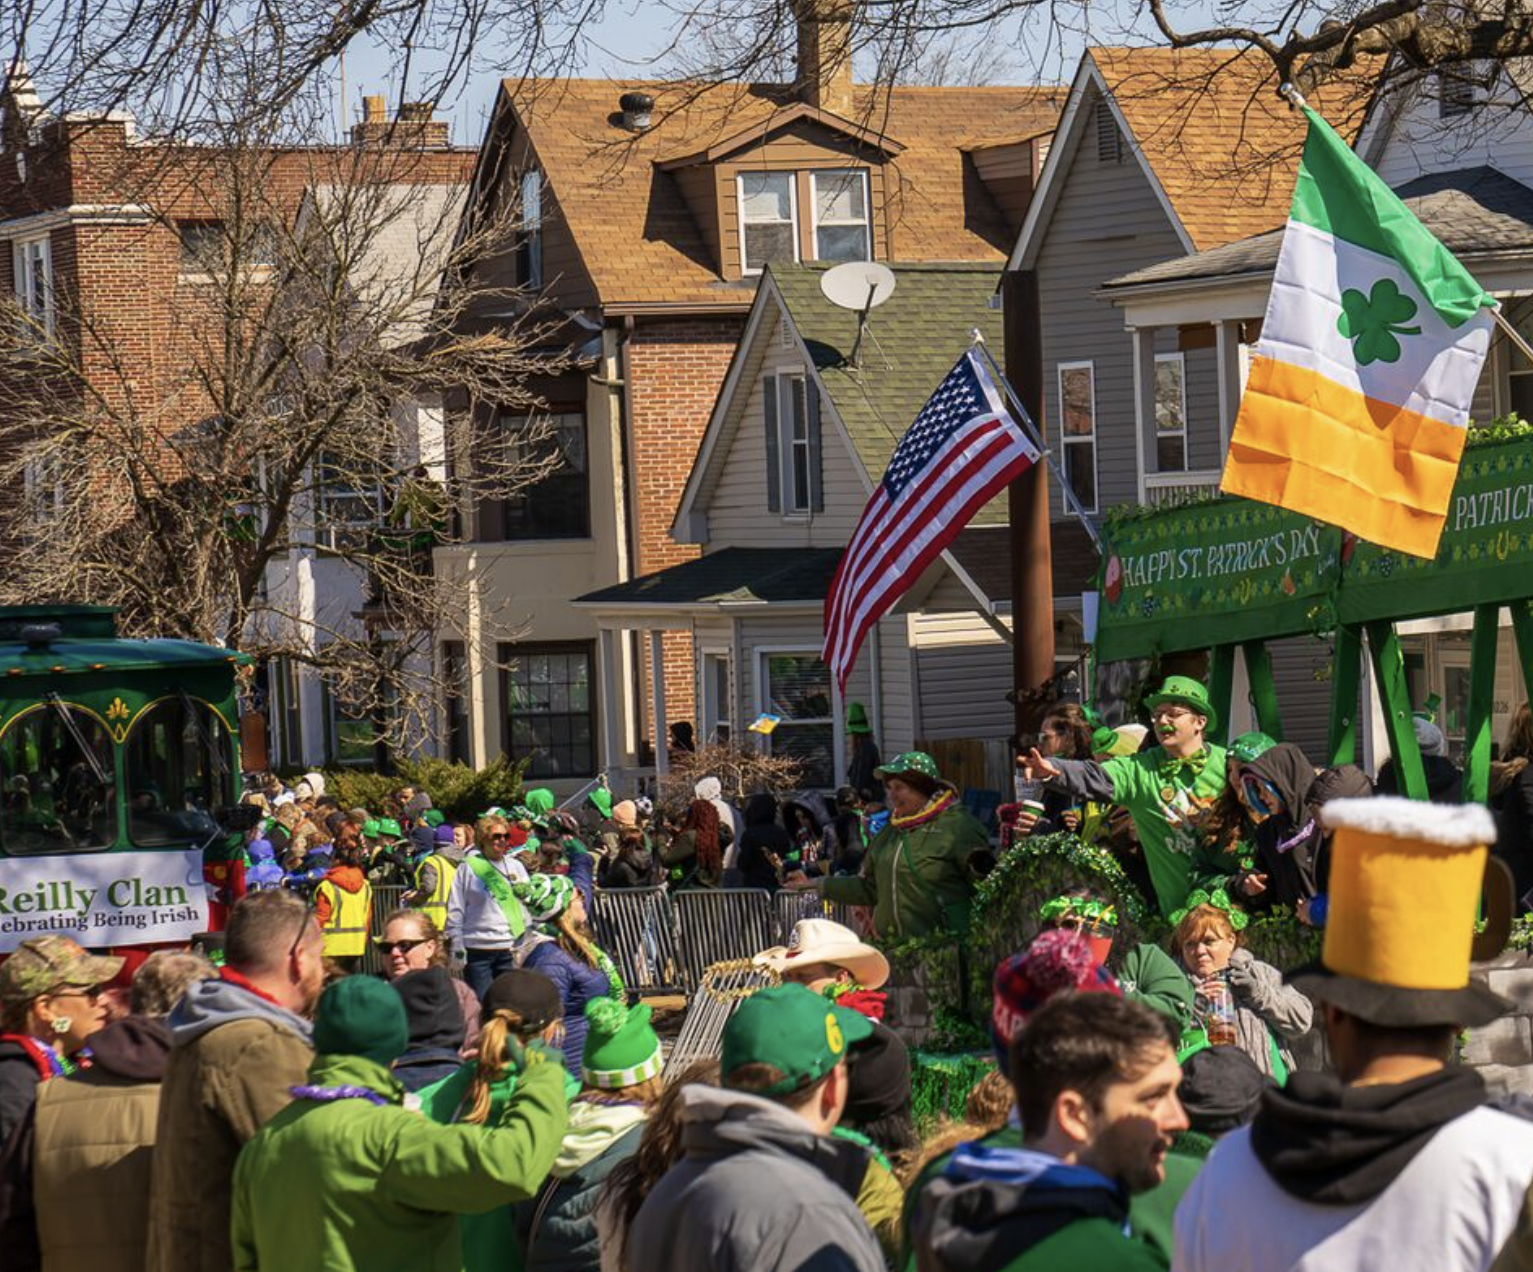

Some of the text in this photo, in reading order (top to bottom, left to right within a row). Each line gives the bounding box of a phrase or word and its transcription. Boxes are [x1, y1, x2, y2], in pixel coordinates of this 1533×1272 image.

[1178, 548, 1203, 579] ST.
[1291, 526, 1320, 561] DAY
[107, 878, 187, 907] Clan
[94, 912, 146, 929] Being
[151, 906, 199, 924] Irish
